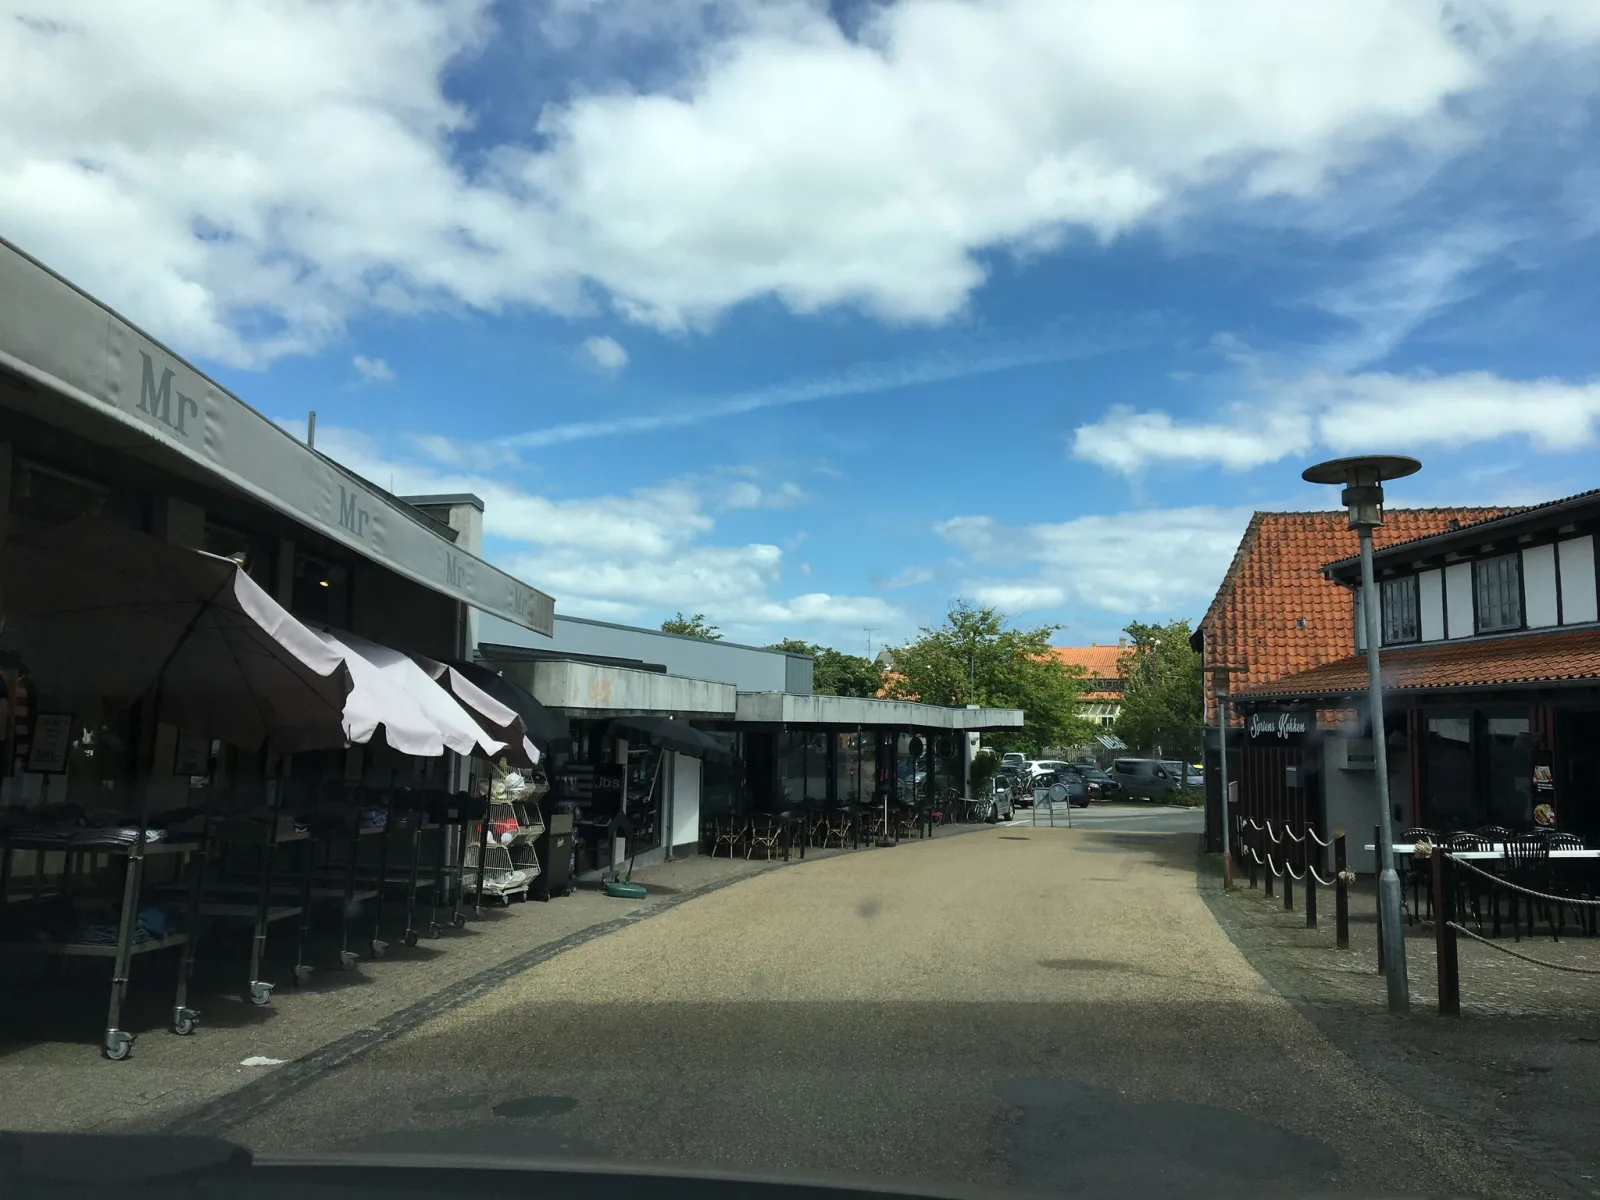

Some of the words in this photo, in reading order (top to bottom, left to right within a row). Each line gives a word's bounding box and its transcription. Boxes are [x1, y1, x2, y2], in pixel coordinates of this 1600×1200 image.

[135, 349, 198, 438] Mr
[338, 484, 370, 538] Mr
[446, 551, 465, 588] Mr
[1250, 713, 1275, 738] Syriens
